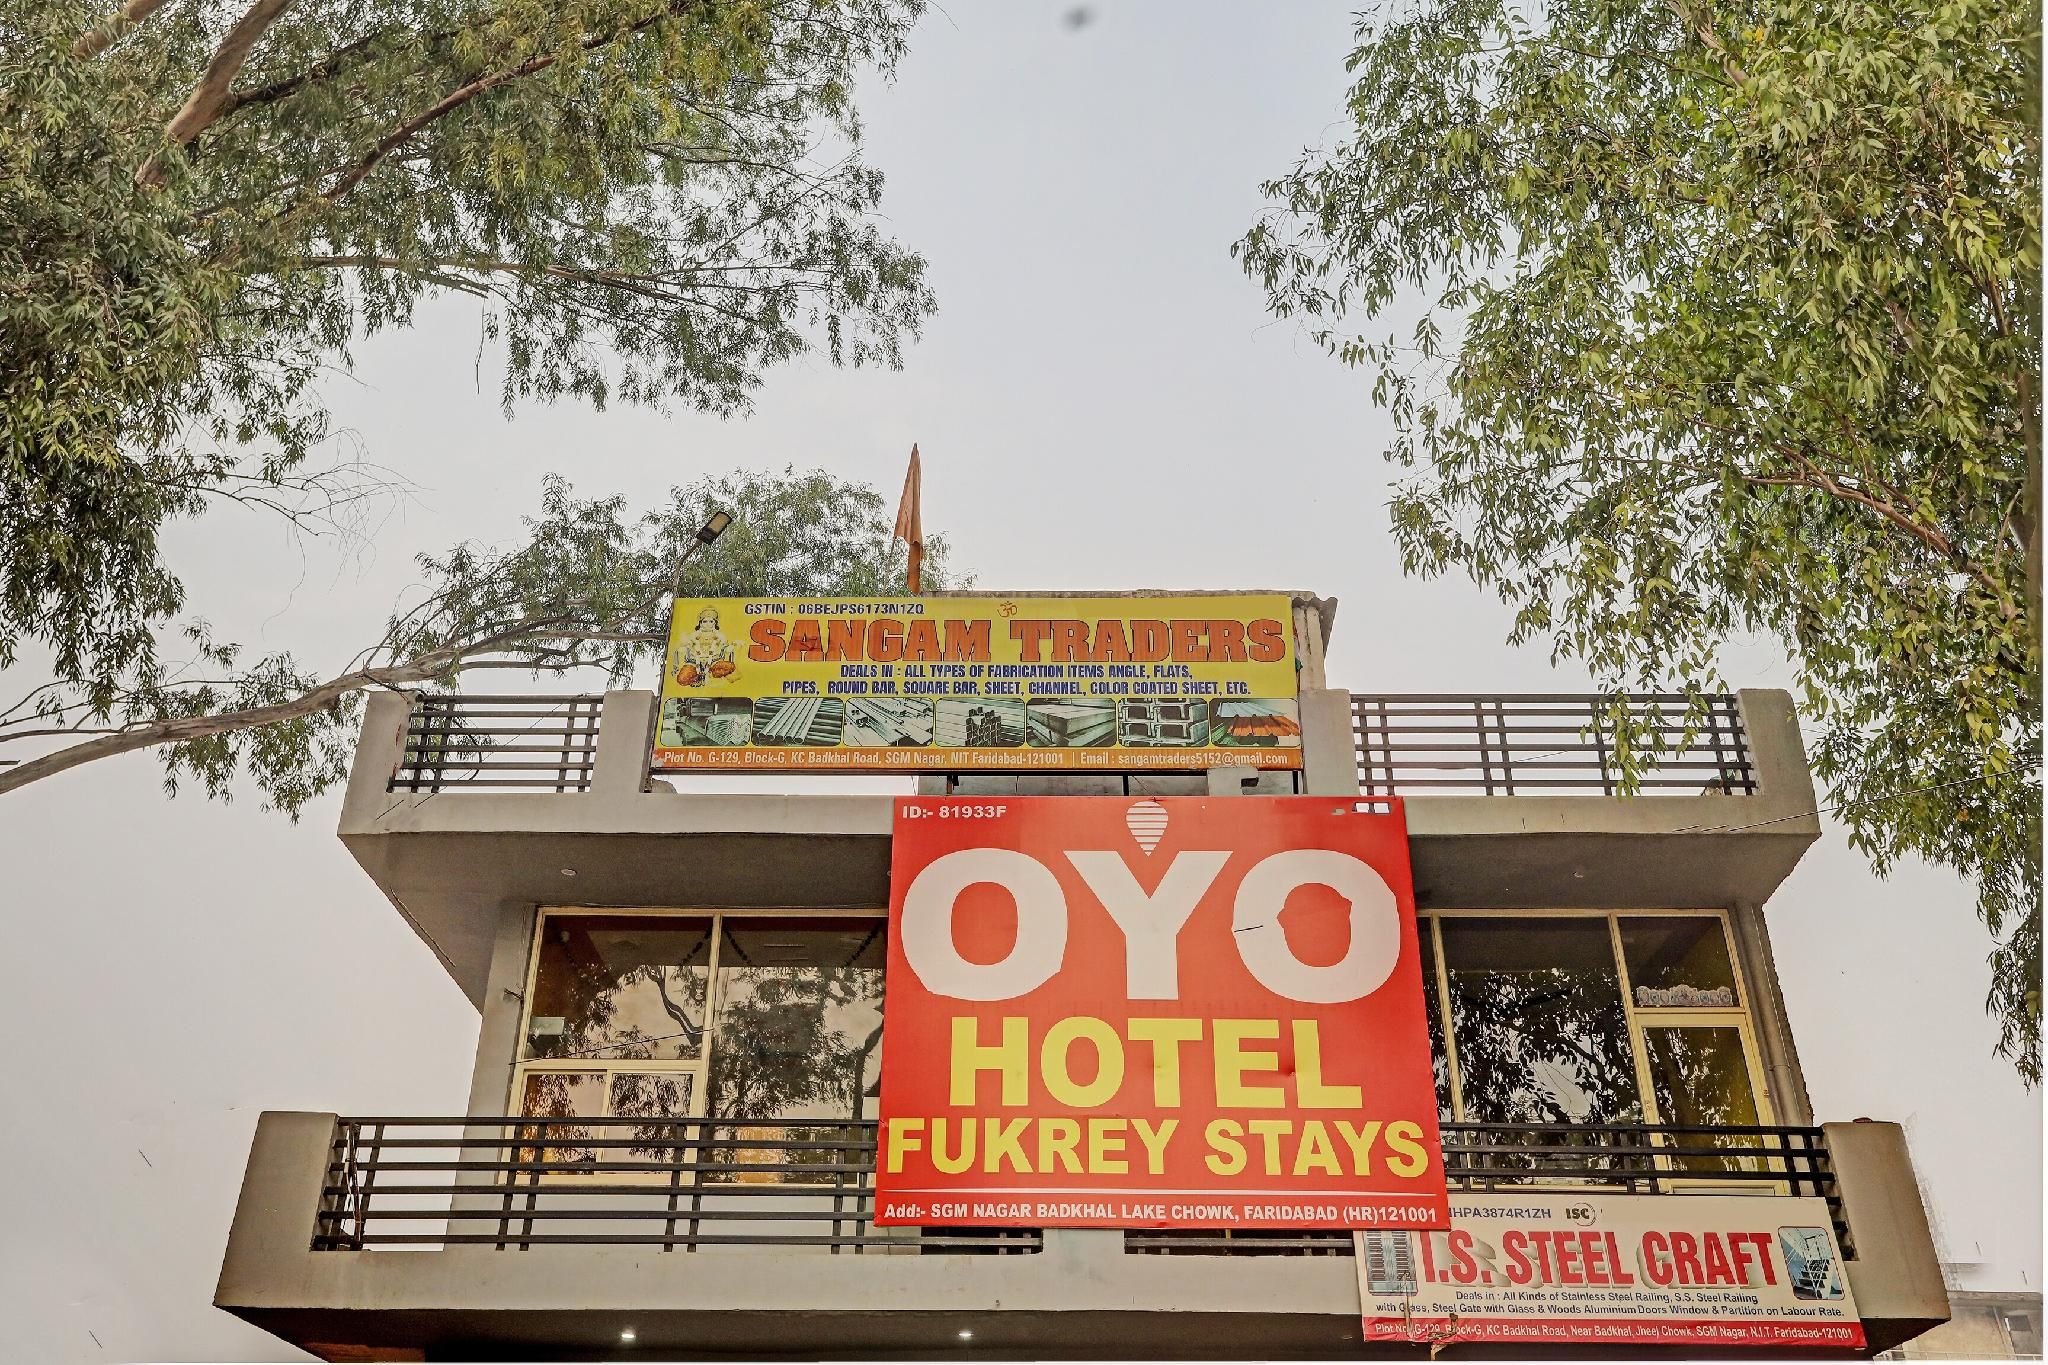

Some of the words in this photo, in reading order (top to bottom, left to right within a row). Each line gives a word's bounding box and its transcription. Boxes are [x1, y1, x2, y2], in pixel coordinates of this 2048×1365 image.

[744, 603, 786, 615] GSTIN
[748, 619, 991, 663] SANGAM
[1009, 619, 1286, 663] TRADERS
[841, 665, 878, 678] DEALS
[881, 665, 894, 678] IN
[905, 665, 926, 678] ALL
[930, 665, 966, 678] TYPES
[970, 665, 984, 678] OF
[988, 665, 1064, 678] FABRICATION
[1067, 665, 1104, 678] ITEMS
[1108, 665, 1150, 679] ANGLE,
[1154, 665, 1192, 679] FLATS,
[783, 681, 820, 695] PIPES,
[828, 681, 868, 695] ROUND
[872, 681, 899, 696] BAR,
[903, 681, 950, 695] SQUARE
[952, 681, 981, 696] BAR,
[984, 681, 1024, 696] SHEET,
[1028, 681, 1086, 696] CHANNEL,
[1090, 681, 1129, 695] COLOR
[1132, 681, 1178, 695] COATED
[1182, 681, 1222, 696] SHEET,
[1226, 681, 1251, 695] ETC.
[664, 752, 684, 764] Plot
[687, 752, 704, 764] No.
[708, 752, 740, 765] G-129,
[744, 752, 787, 765] Block-G,
[791, 752, 805, 764] KC
[808, 752, 850, 764] Badkhal
[853, 752, 882, 765] Road,
[884, 752, 910, 764] SGM
[914, 752, 947, 766] Nagar,
[950, 752, 969, 764] NIT
[972, 752, 1064, 764] Faridabad-121001
[1080, 752, 1108, 764] Email
[1118, 752, 1288, 767] sangamtraders5152@gmail.com
[902, 805, 934, 819] ID:-
[938, 805, 1008, 819] 81933F
[900, 847, 1401, 1003] OYO
[949, 1015, 1363, 1109] HOTEL
[886, 1117, 1180, 1175] FUKREY
[1204, 1117, 1429, 1178] STAYS
[884, 1203, 926, 1218] Add:-
[930, 1203, 968, 1218] SGM
[973, 1203, 1032, 1218] NAGAR
[1036, 1203, 1117, 1219] BADKHAL
[1122, 1204, 1166, 1220] LAKE
[1171, 1205, 1240, 1223] CHOWK,
[1244, 1205, 1338, 1221] FARIDABAD
[1342, 1206, 1437, 1224] (HR)121001
[1449, 1208, 1552, 1219] HPA3874R1ZH
[1419, 1230, 1493, 1285] I.S.
[1502, 1230, 1634, 1285] STEEL
[1641, 1231, 1778, 1286] CRAFT
[1456, 1292, 1483, 1301] Deals
[1486, 1292, 1495, 1301] in
[1503, 1292, 1516, 1301] All
[1518, 1292, 1546, 1301] Kinds
[1549, 1292, 1560, 1301] of
[1561, 1292, 1605, 1302] Stainless
[1608, 1292, 1633, 1302] Steel
[1636, 1292, 1672, 1304] Railing,
[1675, 1293, 1694, 1302] S.S.
[1697, 1293, 1721, 1302] Steel
[1724, 1294, 1758, 1305] Railing
[1376, 1303, 1396, 1312] with
[1432, 1303, 1455, 1312] Steel
[1459, 1303, 1482, 1313] Gate
[1484, 1303, 1505, 1313] with
[1508, 1303, 1536, 1313] Glass
[1538, 1304, 1545, 1313] &
[1548, 1304, 1582, 1314] Woods
[1584, 1304, 1637, 1314] Aluminium
[1638, 1305, 1668, 1314] Doors
[1670, 1305, 1709, 1315] Window
[1712, 1306, 1719, 1315] &
[1722, 1306, 1763, 1316] Partition
[1766, 1308, 1778, 1316] on
[1781, 1306, 1816, 1317] Labour
[1819, 1308, 1845, 1317] Rate.
[1376, 1324, 1394, 1332] Plot
[1486, 1324, 1500, 1335] KC
[1502, 1324, 1540, 1336] Badkhal
[1542, 1325, 1568, 1337] Road,
[1571, 1326, 1592, 1336] Near
[1696, 1326, 1718, 1336] SGM
[1720, 1326, 1749, 1339] Nagar,
[1750, 1327, 1773, 1338] N.I.T.
[1775, 1327, 1853, 1339] Faridabad-121001
